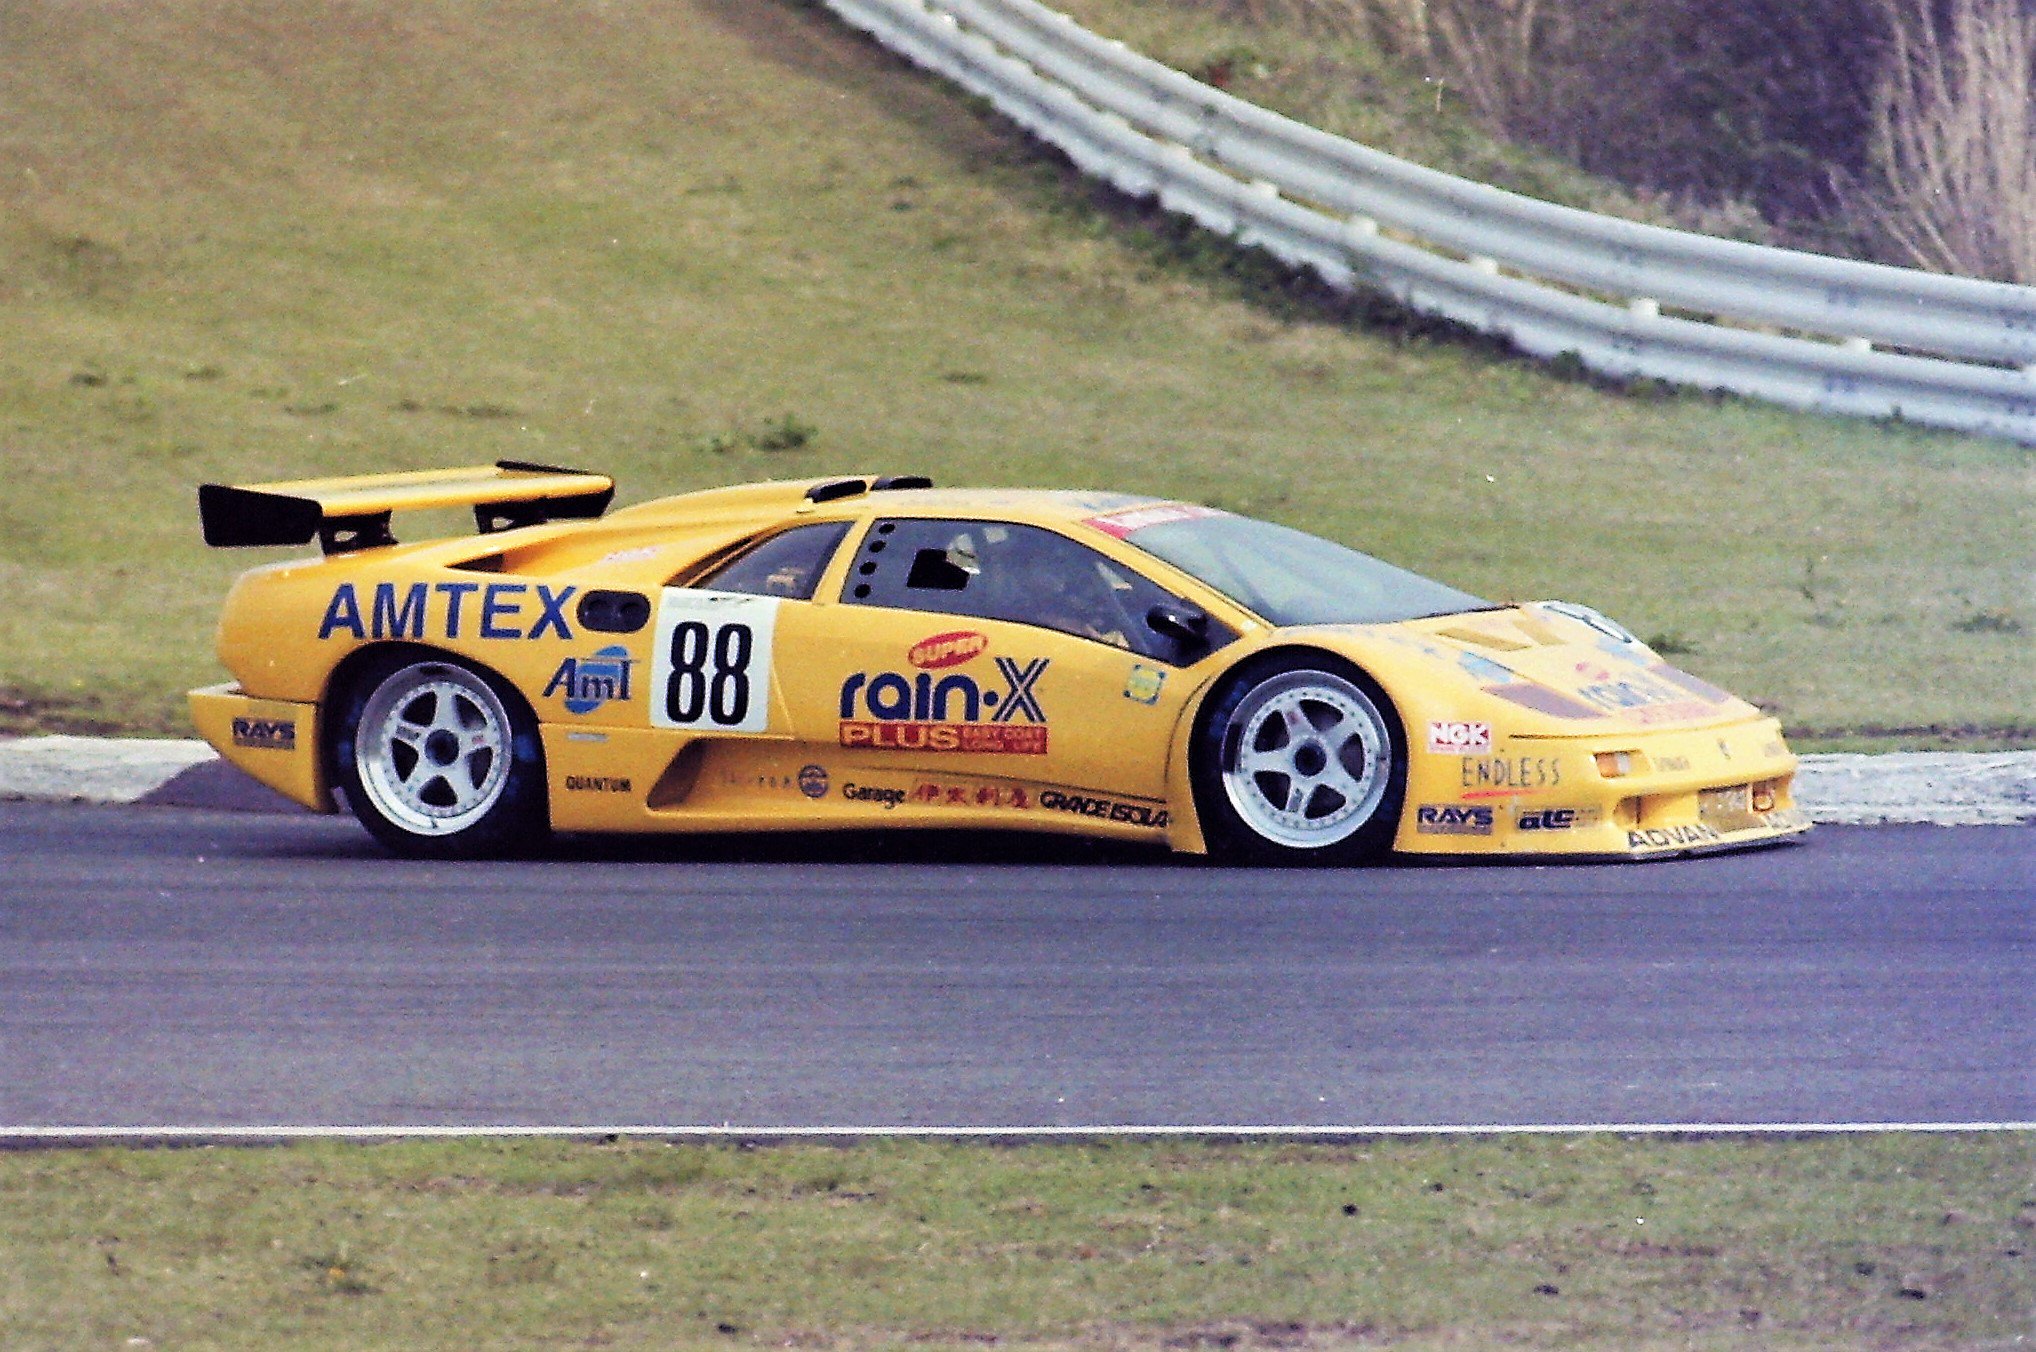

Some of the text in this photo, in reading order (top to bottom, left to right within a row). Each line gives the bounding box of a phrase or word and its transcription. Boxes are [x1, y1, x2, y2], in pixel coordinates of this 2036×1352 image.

[317, 582, 577, 640] AMTEX
[666, 621, 753, 726] 88
[233, 720, 295, 740] RAYS
[842, 724, 961, 750] PLUS
[1431, 723, 1489, 745] NGK
[1462, 757, 1560, 787] ENDLESS
[843, 783, 905, 809] Garage
[1418, 807, 1493, 826] RAYS
[1628, 825, 1719, 849] ADVAN
